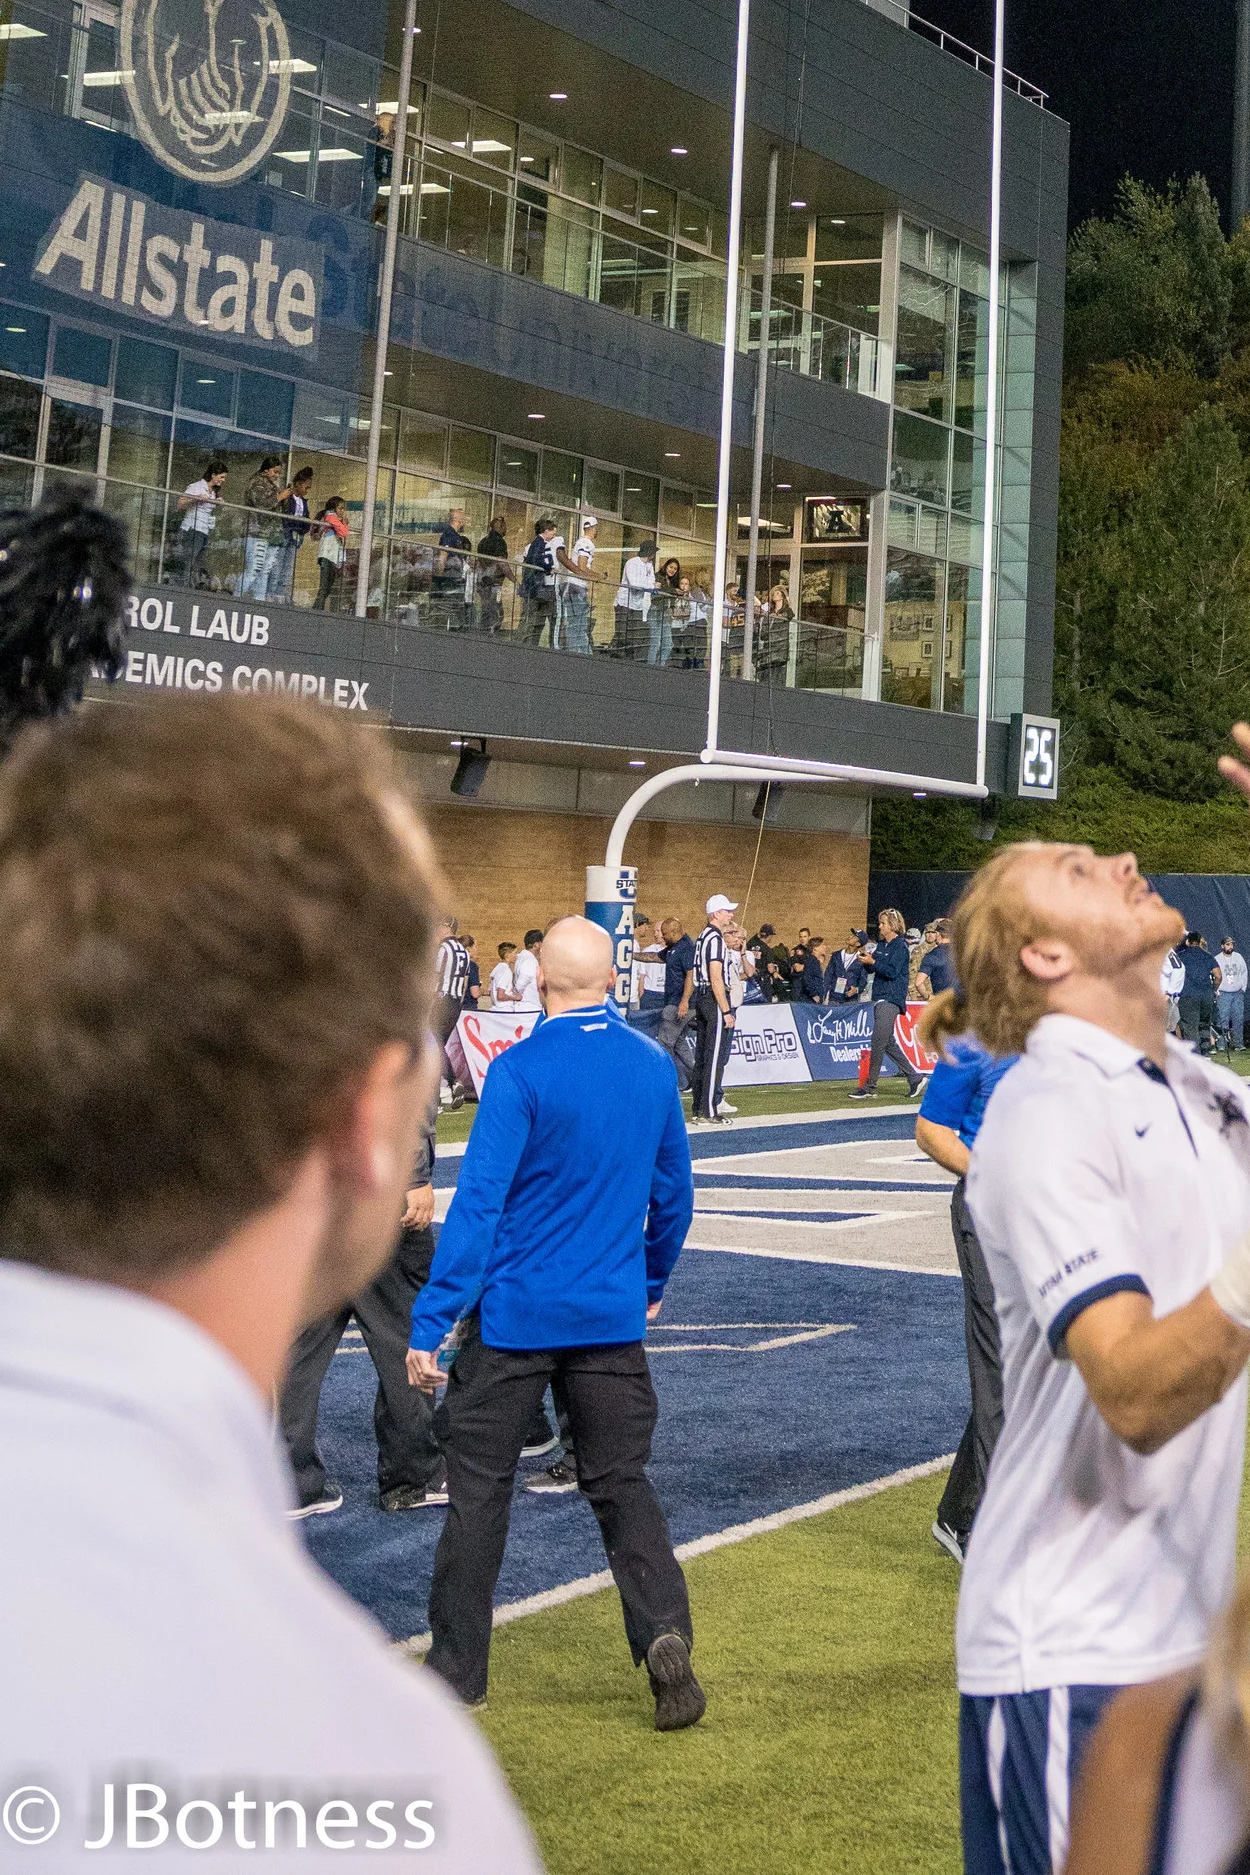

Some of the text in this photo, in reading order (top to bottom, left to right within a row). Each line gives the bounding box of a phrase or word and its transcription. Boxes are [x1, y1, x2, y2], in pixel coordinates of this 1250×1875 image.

[35, 180, 316, 347] Allstate
[190, 605, 270, 646] LAUB
[232, 664, 370, 711] COMPLEX
[1024, 726, 1053, 785] 25
